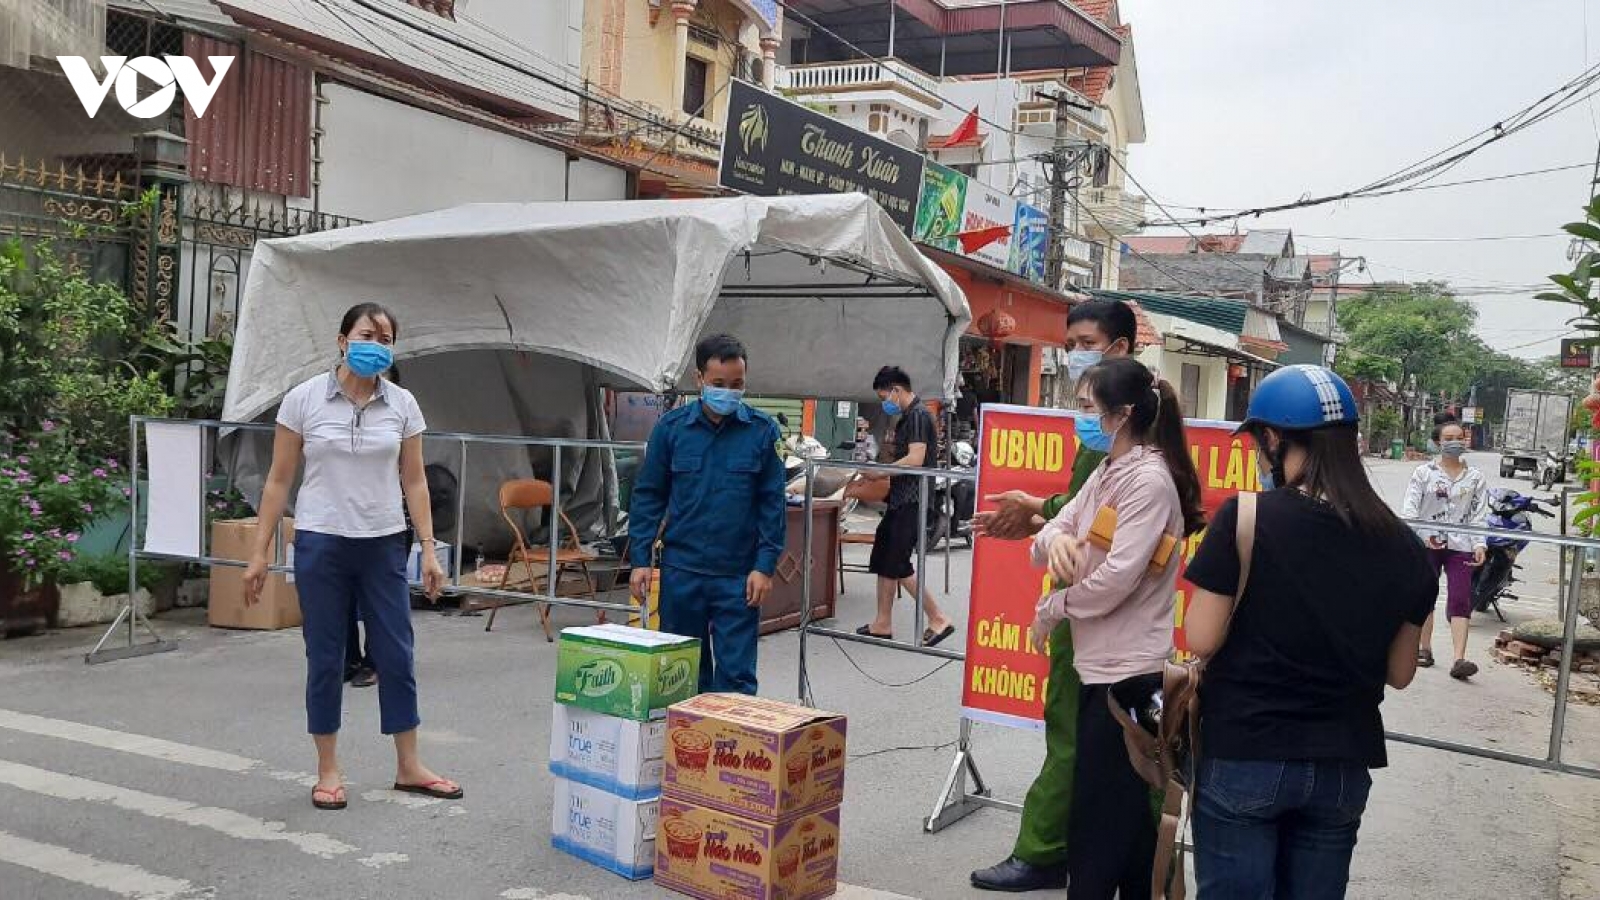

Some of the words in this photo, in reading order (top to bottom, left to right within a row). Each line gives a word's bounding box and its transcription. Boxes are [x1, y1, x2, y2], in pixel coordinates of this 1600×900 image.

[801, 123, 854, 169] Thanh
[857, 146, 900, 184] Xuân
[989, 428, 1063, 472] UBND
[976, 612, 1020, 652] CẤM
[576, 661, 616, 692] Faith
[971, 664, 1036, 702] KHÔNG
[569, 734, 592, 754] true
[743, 748, 772, 771] Hảo
[570, 808, 592, 830] true
[732, 842, 762, 865] Hảo
